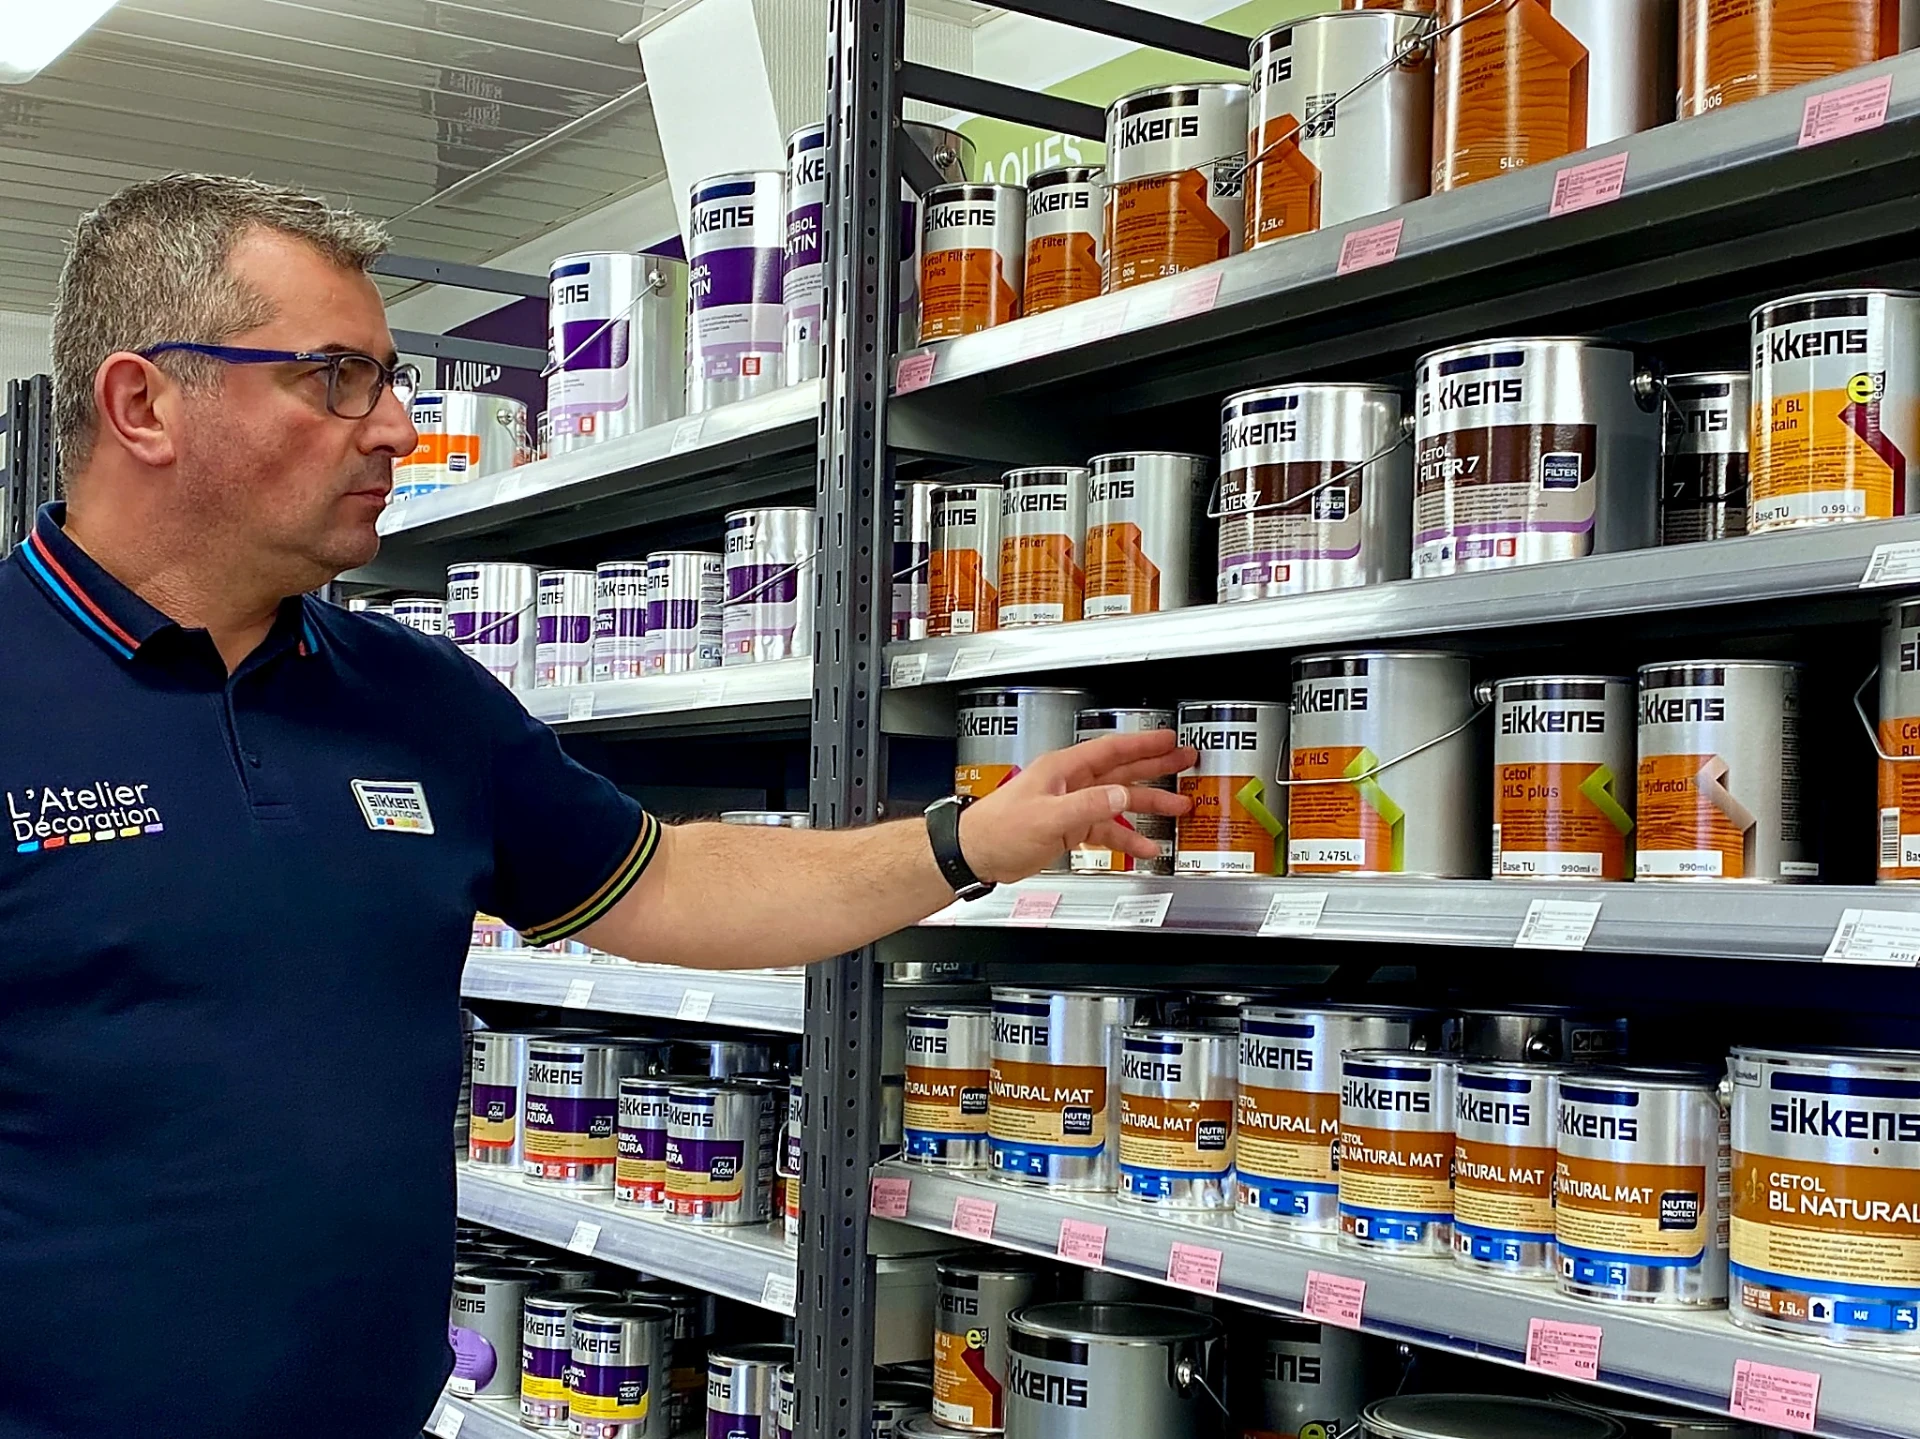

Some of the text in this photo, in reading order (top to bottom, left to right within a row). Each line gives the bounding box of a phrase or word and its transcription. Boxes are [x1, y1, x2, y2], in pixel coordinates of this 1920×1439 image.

[924, 205, 996, 234] sikkens
[1786, 399, 1803, 414] BL
[1419, 446, 1450, 464] CETOL
[1420, 455, 1481, 482] FILTER 7
[1545, 468, 1578, 477] FILTER
[1672, 482, 1685, 498] 7
[1775, 506, 1789, 519] TU
[1020, 536, 1047, 549] Filter
[1501, 705, 1605, 734] sikkens
[1179, 726, 1258, 750] sikkens
[1309, 751, 1329, 766] HLS
[1503, 766, 1532, 781] Cetol
[1503, 783, 1559, 801] HLS plus
[8, 782, 149, 819] L'Atelier
[367, 794, 420, 810] sikkens
[1195, 794, 1220, 808] plus
[372, 808, 424, 820] SOLUTIONS
[13, 806, 160, 841] Décoration
[1300, 850, 1310, 862] TU
[1191, 859, 1201, 869] TU
[1220, 861, 1244, 870] 990ml
[1522, 861, 1535, 872] TU
[1561, 863, 1590, 873] 990ml
[1679, 862, 1708, 872] 990ml
[1239, 1039, 1313, 1072] sikkens
[931, 1084, 957, 1098] MAT
[1054, 1088, 1094, 1104] MAT
[1342, 1080, 1430, 1113] sikkens
[1064, 1111, 1091, 1122] NUTRI
[1064, 1118, 1090, 1127] PROTECT
[1246, 1111, 1316, 1134] NATURAL
[1769, 1096, 1920, 1143] sikkens
[1162, 1117, 1193, 1132] MAT
[1199, 1126, 1226, 1136] NUTRI
[1349, 1147, 1407, 1168] NATURAL
[1409, 1152, 1444, 1169] MAT
[711, 1167, 735, 1176] FLOW
[1457, 1161, 1545, 1187] NATURAL MAT
[1769, 1172, 1826, 1193] CETOL
[1559, 1178, 1654, 1205] NATURAL MAT
[1662, 1198, 1697, 1210] NUTRI
[1768, 1189, 1799, 1214] BL
[1662, 1209, 1696, 1219] PROTECT
[1853, 1309, 1870, 1321] MAT
